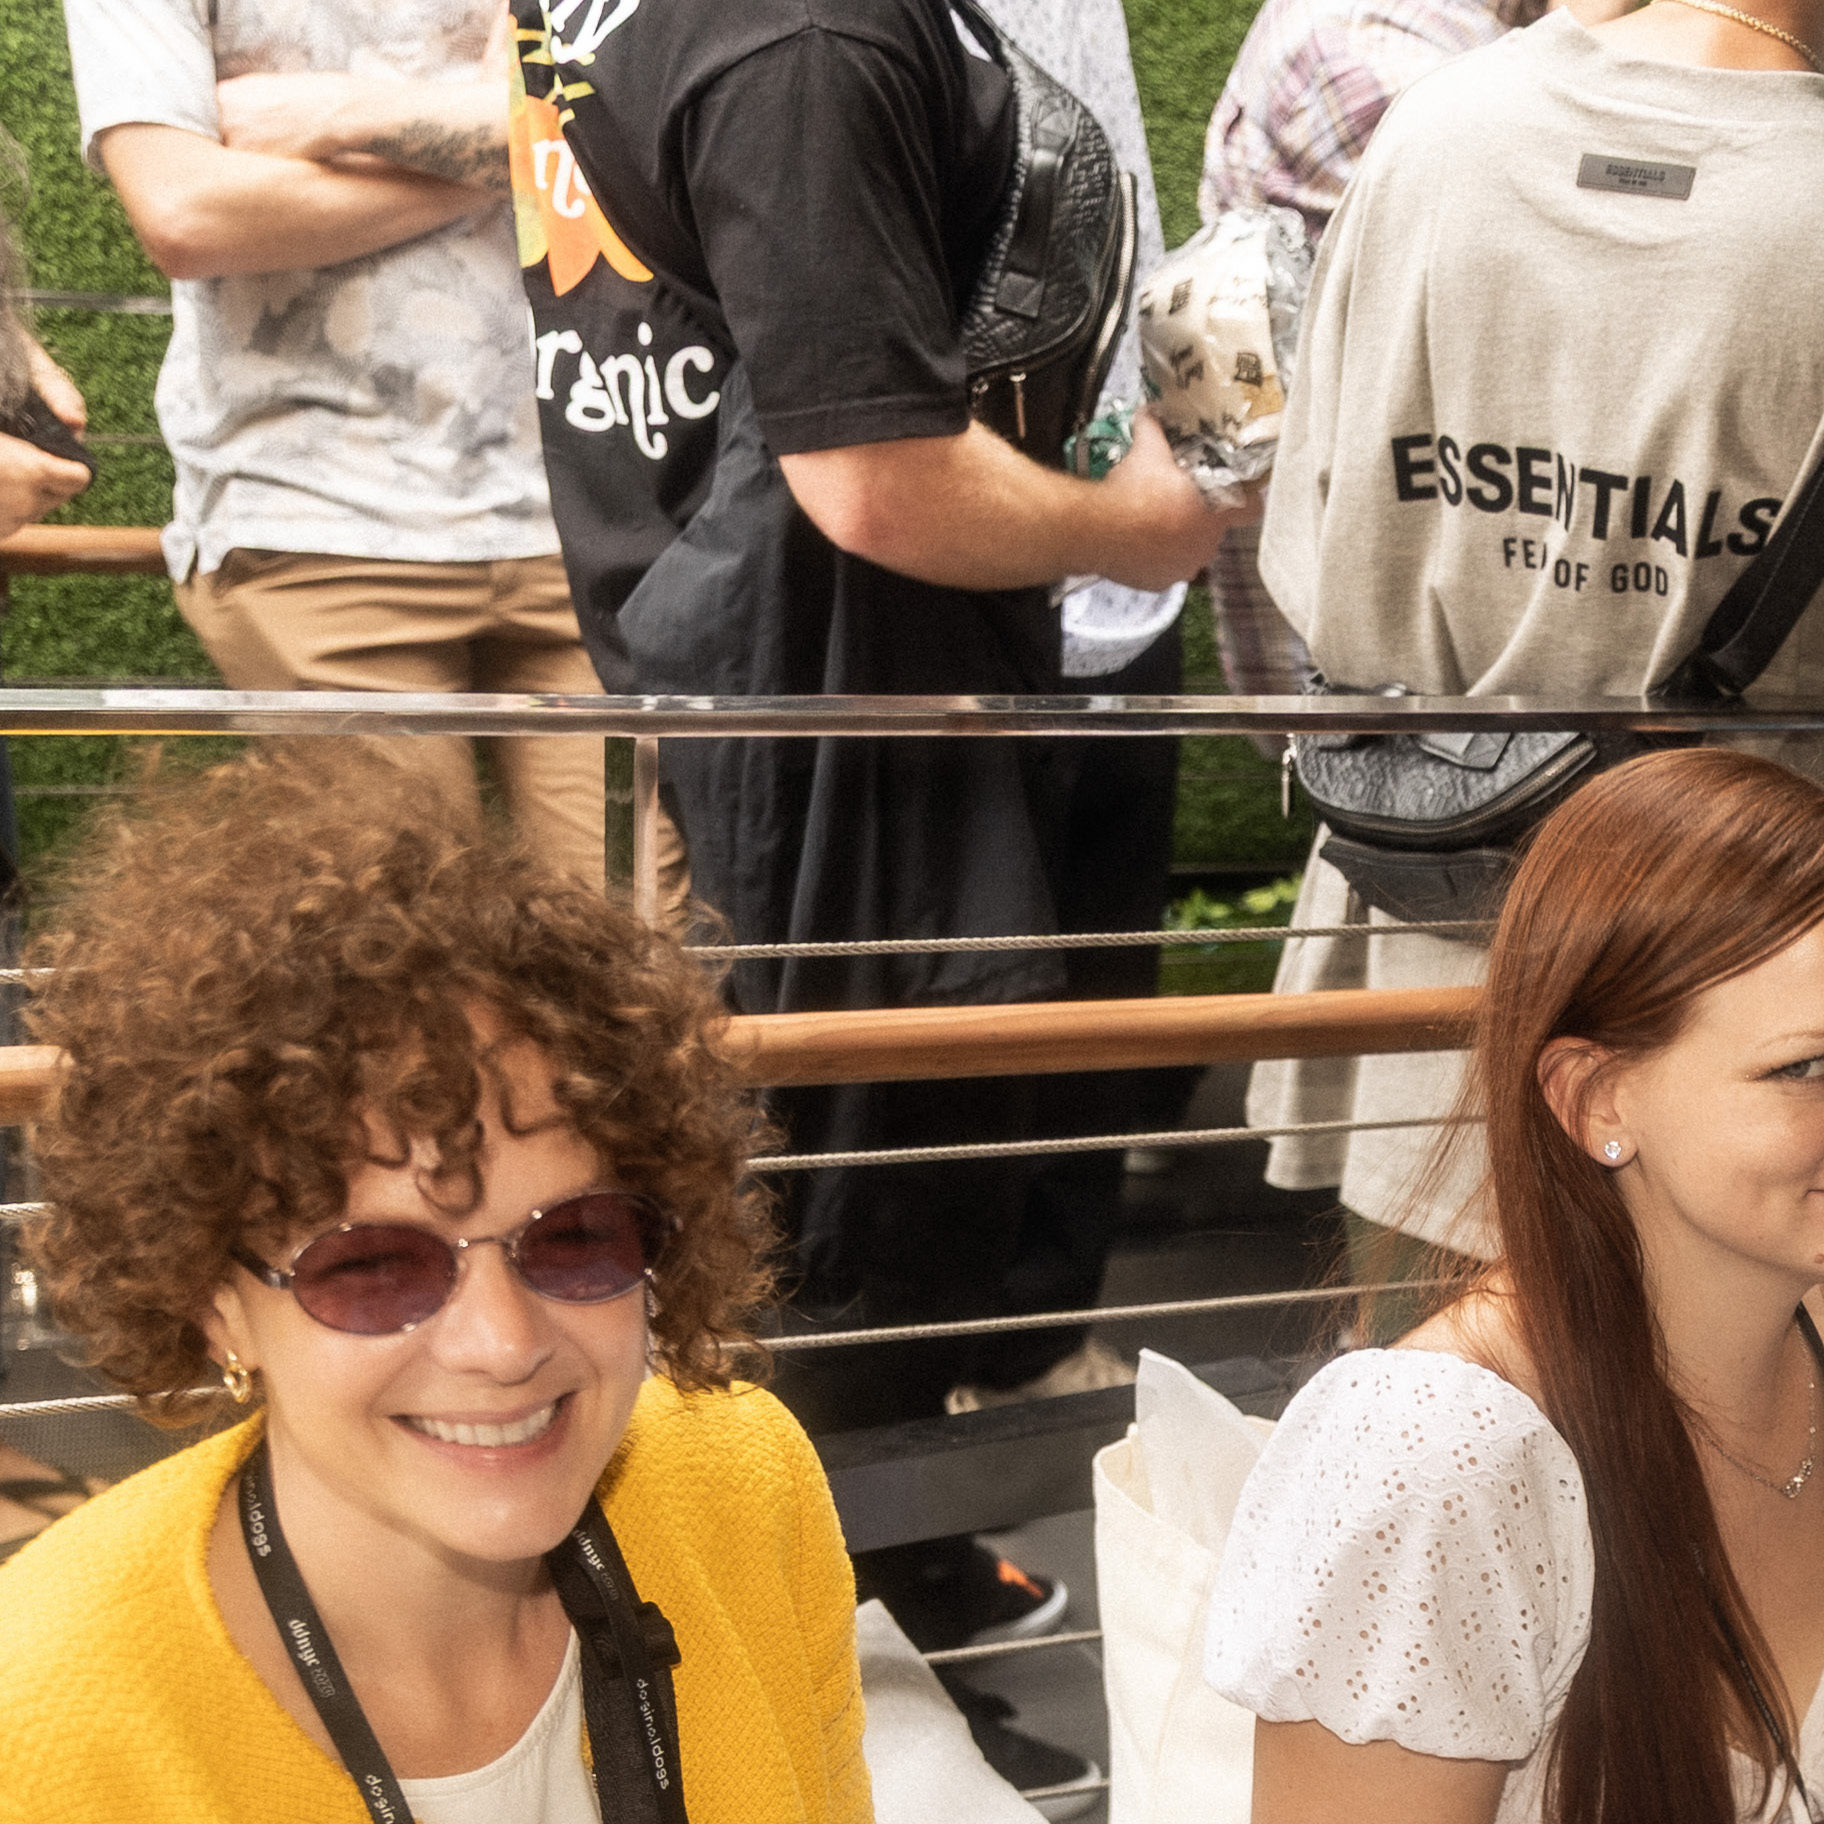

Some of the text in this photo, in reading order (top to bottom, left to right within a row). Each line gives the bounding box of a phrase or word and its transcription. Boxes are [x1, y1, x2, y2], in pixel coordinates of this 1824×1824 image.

[1390, 433, 1785, 562] ESSENTIALS
[1553, 555, 1589, 590] OF
[1610, 561, 1669, 598] GOD
[636, 1678, 669, 1790] doginaldogs
